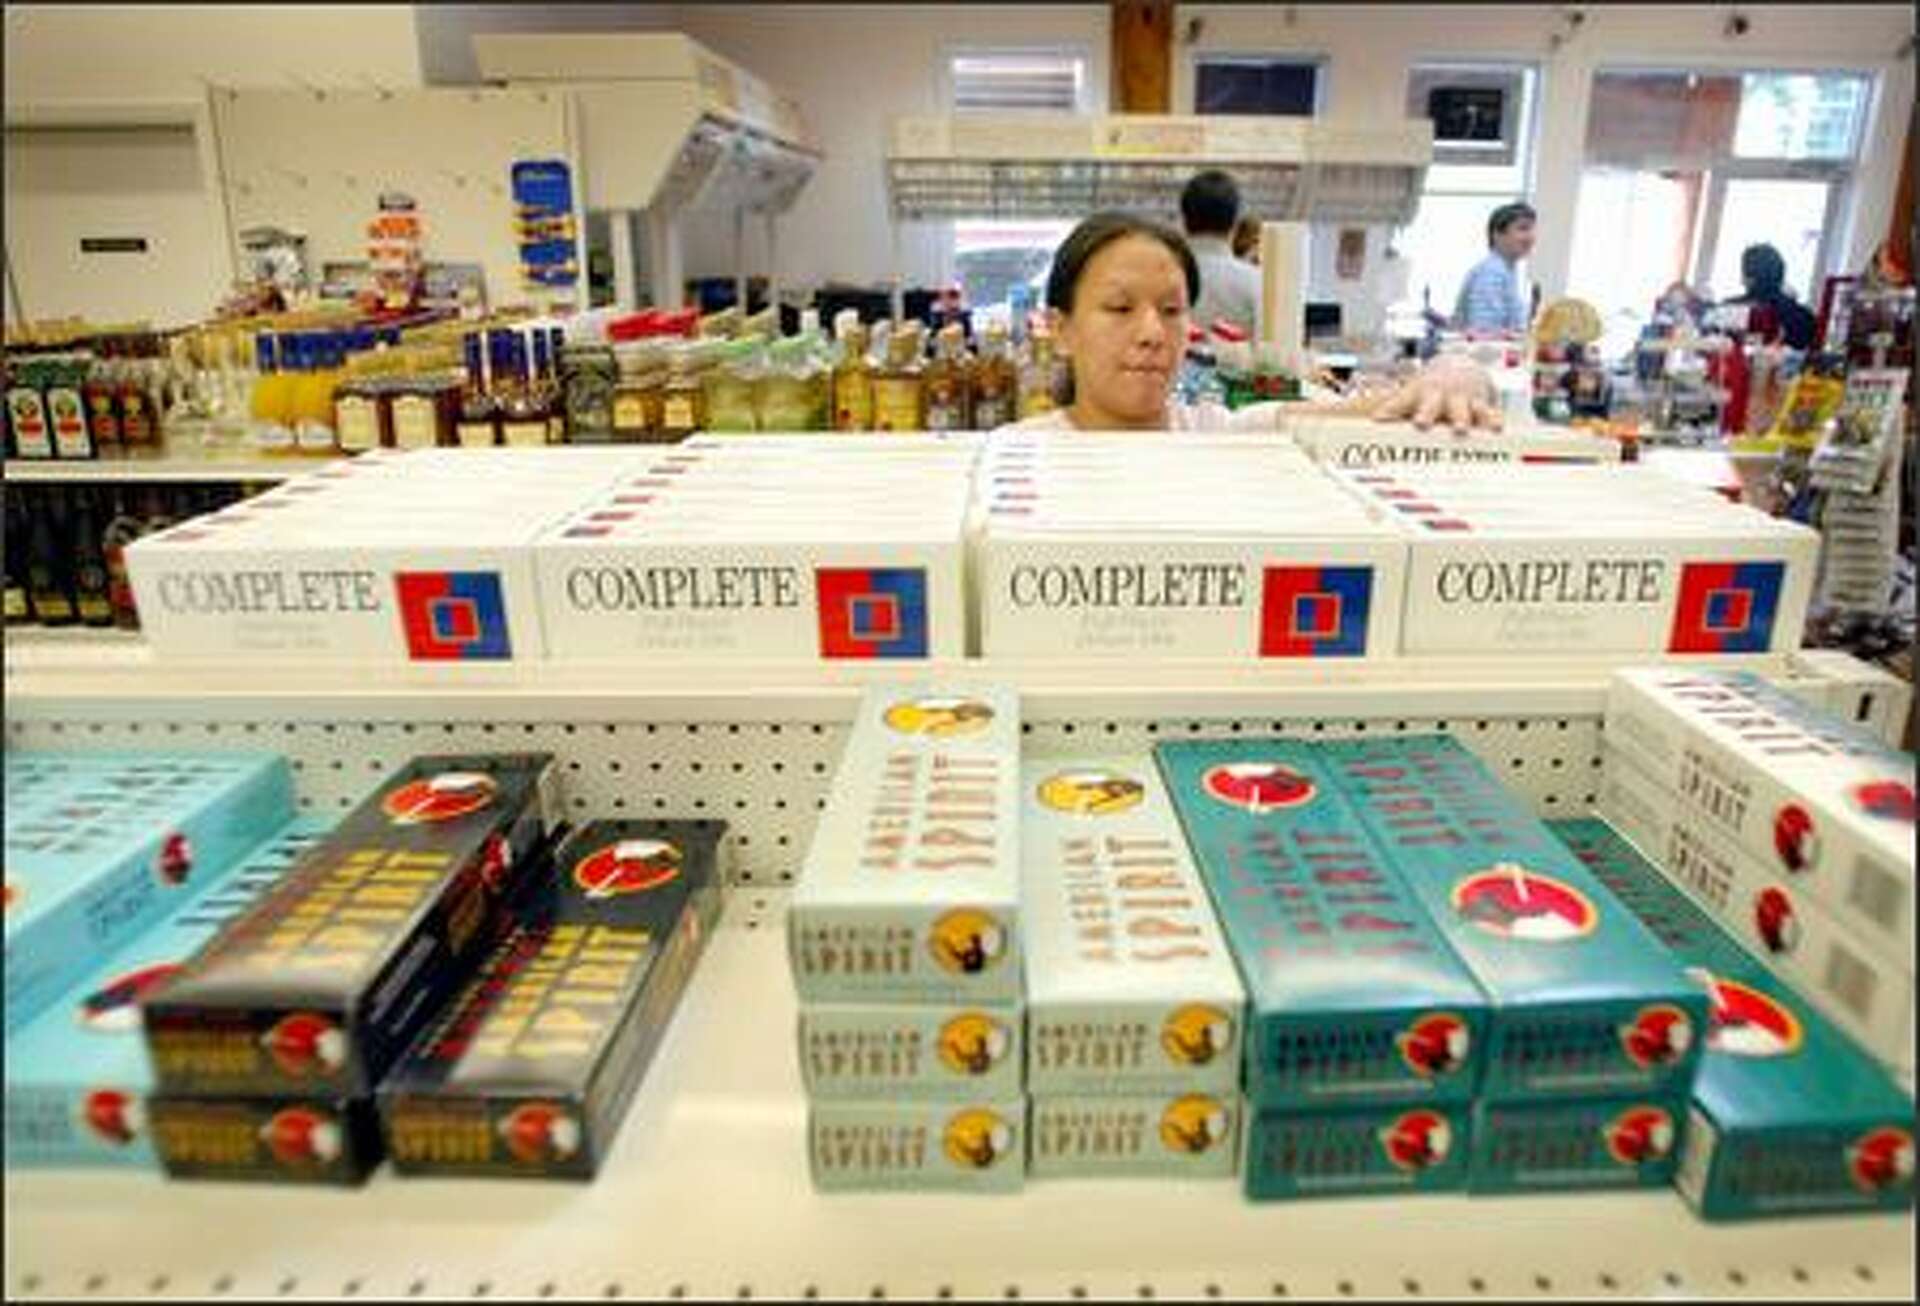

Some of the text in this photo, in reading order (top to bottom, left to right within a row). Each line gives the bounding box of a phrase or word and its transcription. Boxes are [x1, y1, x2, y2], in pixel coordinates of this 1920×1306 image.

[158, 571, 381, 613] COMPLETE
[566, 567, 799, 609] COMPLETE
[1010, 564, 1246, 607] COMPLETE
[1437, 560, 1664, 603] COMPLETE
[913, 754, 997, 868] SPIRIT
[1105, 836, 1209, 961] SPIRIT
[801, 947, 911, 973] SPIRIT
[811, 1052, 918, 1076] SPIRIT
[1038, 1043, 1144, 1067] SPIRIT
[819, 1144, 924, 1168] SPIRIT
